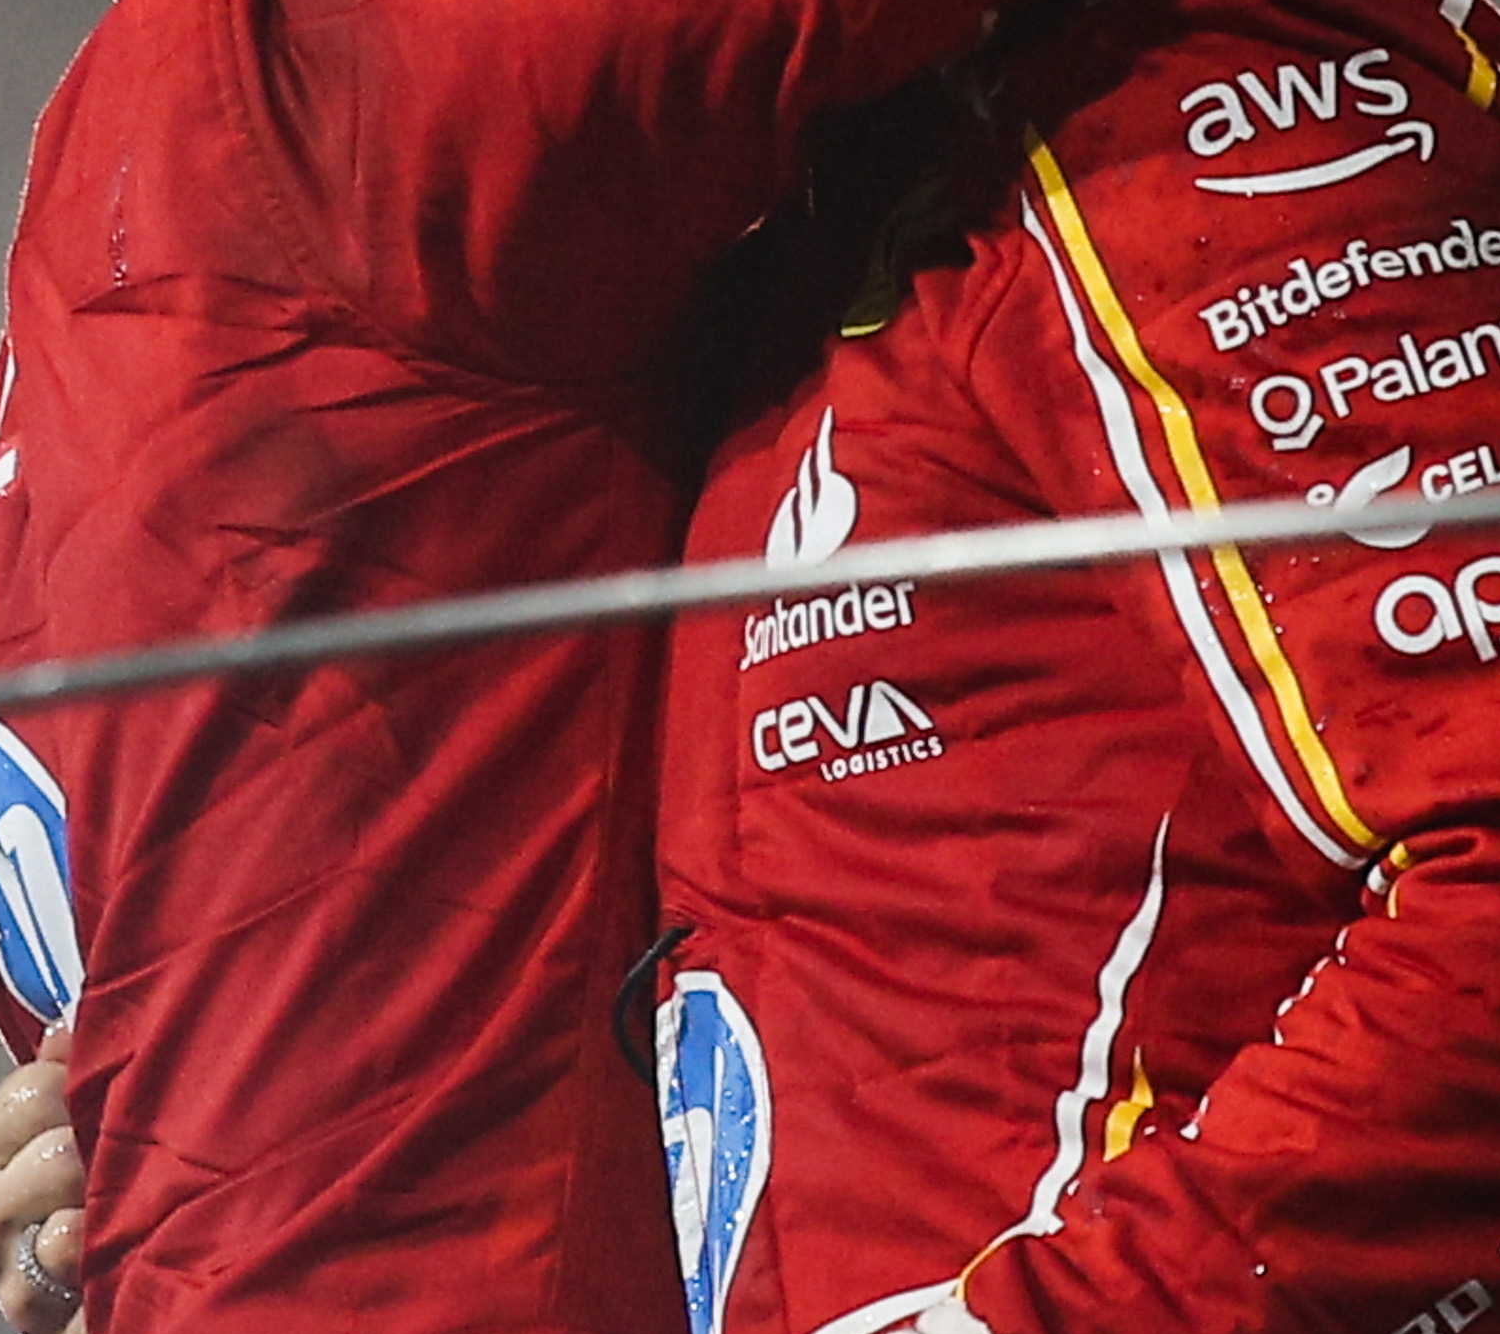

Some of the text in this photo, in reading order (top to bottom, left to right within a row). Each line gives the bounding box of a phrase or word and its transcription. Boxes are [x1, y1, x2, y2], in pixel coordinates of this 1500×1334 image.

[1180, 48, 1409, 157] aws
[739, 582, 914, 671] Santander
[821, 736, 943, 781] LOGISTICS
